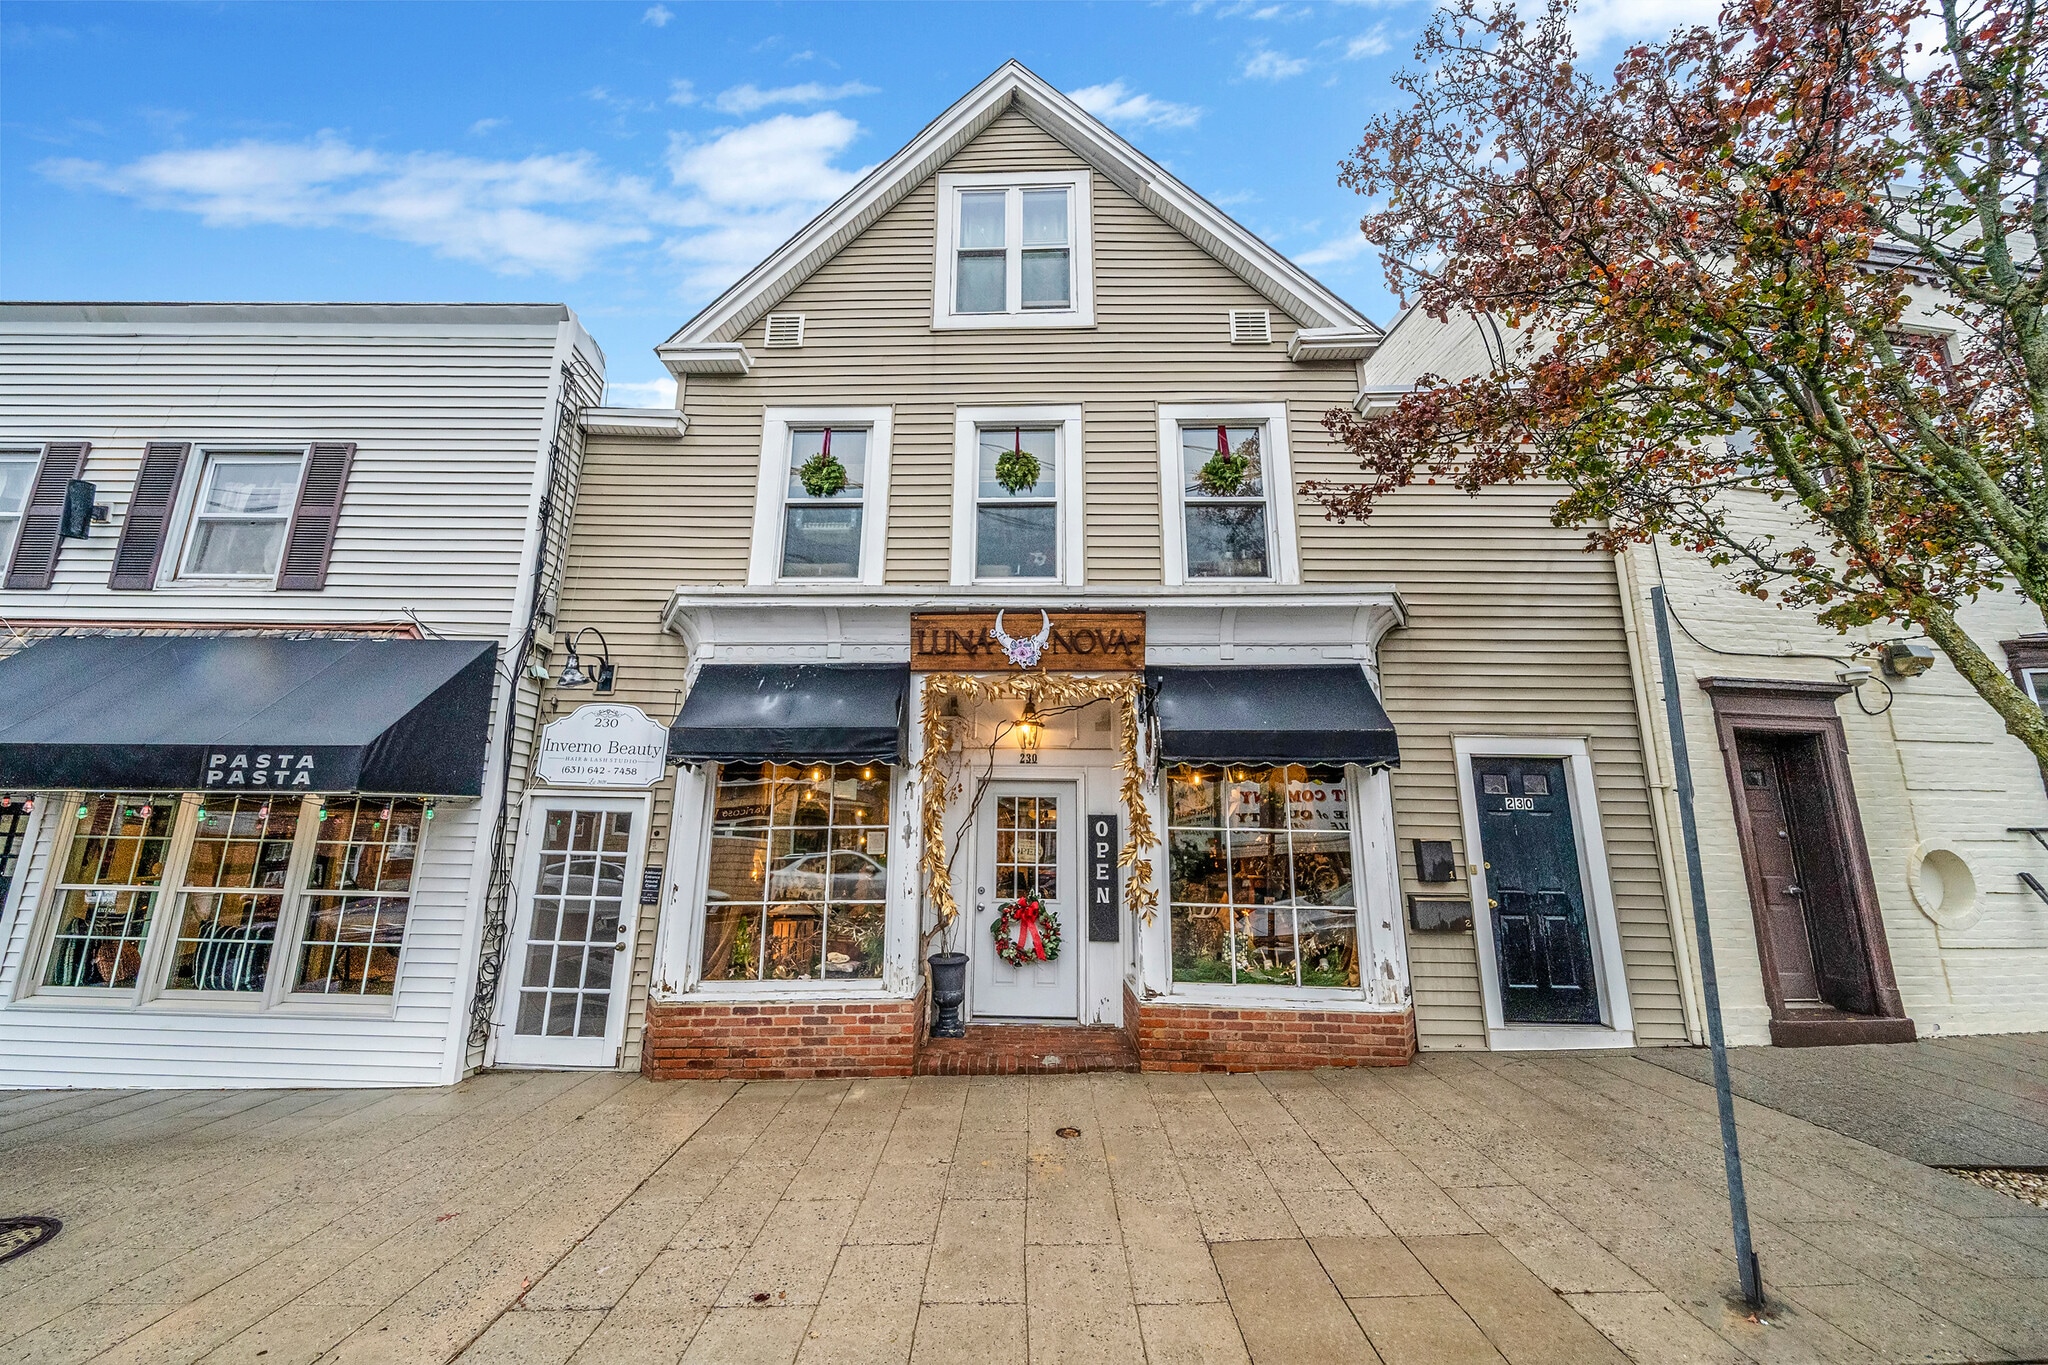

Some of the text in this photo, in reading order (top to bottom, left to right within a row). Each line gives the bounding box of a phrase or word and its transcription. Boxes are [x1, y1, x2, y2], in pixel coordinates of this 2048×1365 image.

[916, 627, 1133, 655] LUNA NOVA
[594, 717, 619, 728] 230
[544, 738, 662, 758] Inverno Beauty
[209, 754, 315, 768] PASTA
[1019, 753, 1038, 764] 230
[561, 766, 585, 775] (631)
[587, 766, 606, 775] 642
[614, 767, 638, 775] 7458
[206, 770, 311, 784] PASTA
[1506, 798, 1533, 809] 230
[1095, 821, 1110, 904] OPEN
[1449, 870, 1455, 879] 1
[1464, 919, 1472, 928] 2
